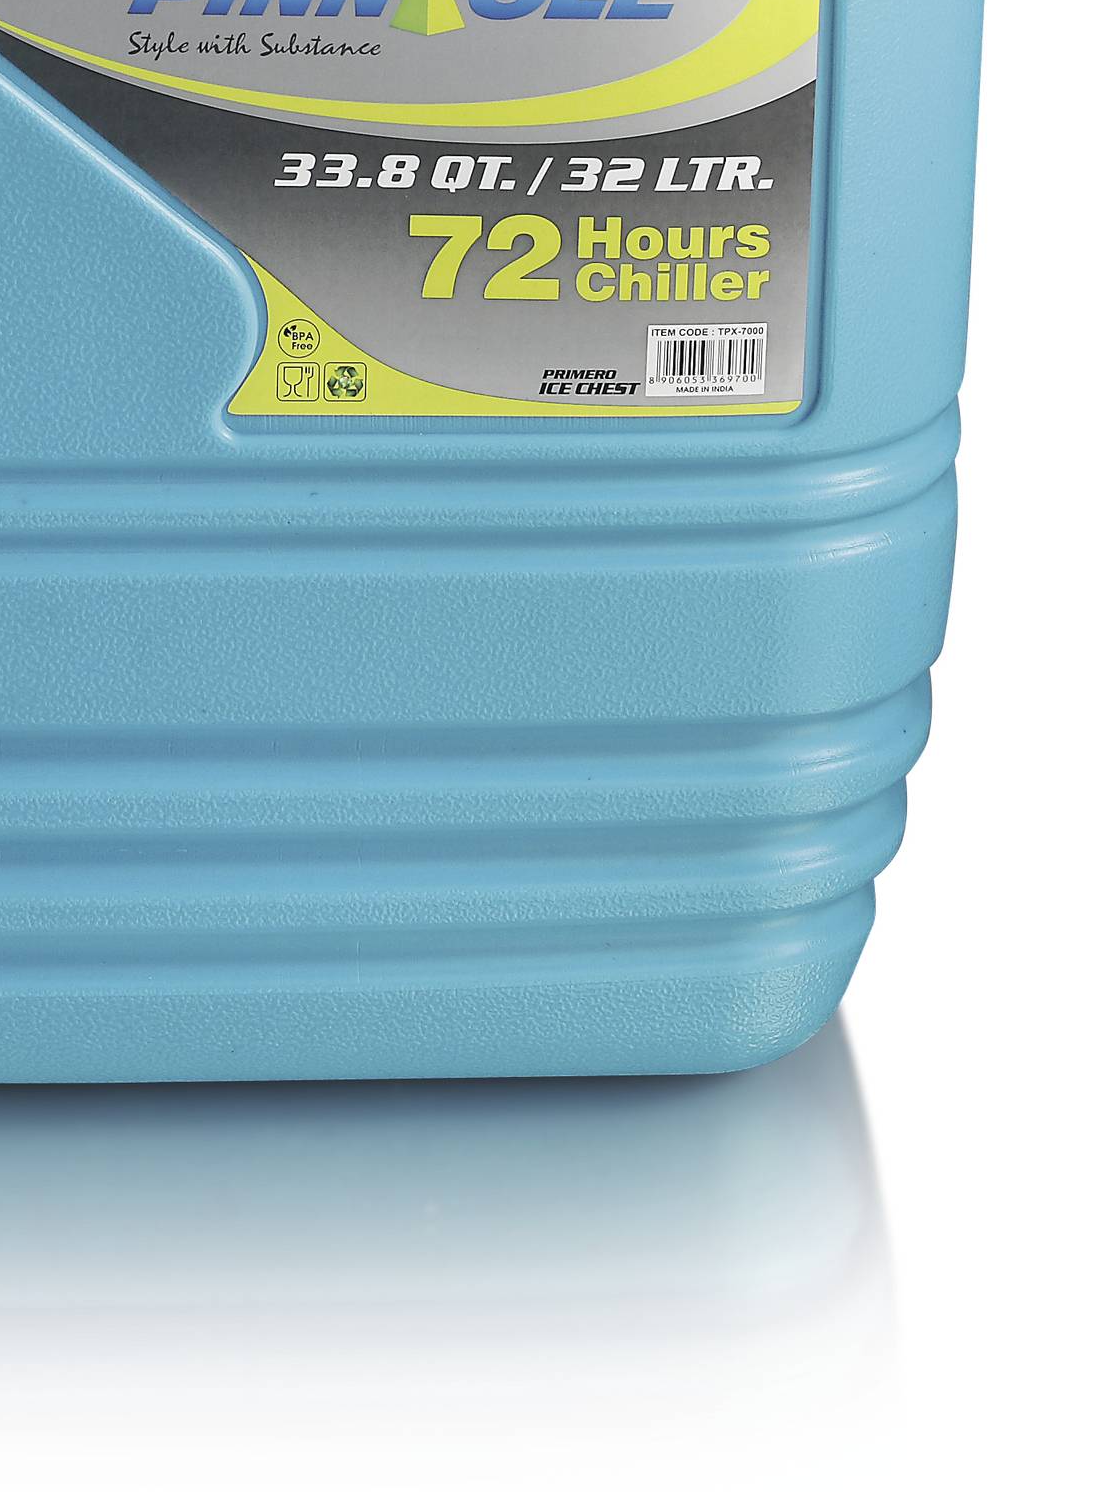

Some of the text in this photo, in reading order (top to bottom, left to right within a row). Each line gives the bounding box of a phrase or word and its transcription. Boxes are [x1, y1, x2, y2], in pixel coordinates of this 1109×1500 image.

[128, 30, 382, 61] Style with Substance
[274, 153, 775, 195] 33.8 QT. / 32 LTR.
[409, 214, 771, 300] 72 Hours
[575, 262, 770, 301] Chiller
[292, 331, 314, 341] BPA
[651, 328, 676, 337] ITEM
[678, 327, 708, 337] CODE
[718, 327, 764, 336] TPX-7000
[291, 341, 313, 350] Free
[542, 369, 618, 380] PRIMERO
[538, 382, 641, 395] ICE CHEST
[711, 385, 734, 393] INDIA
